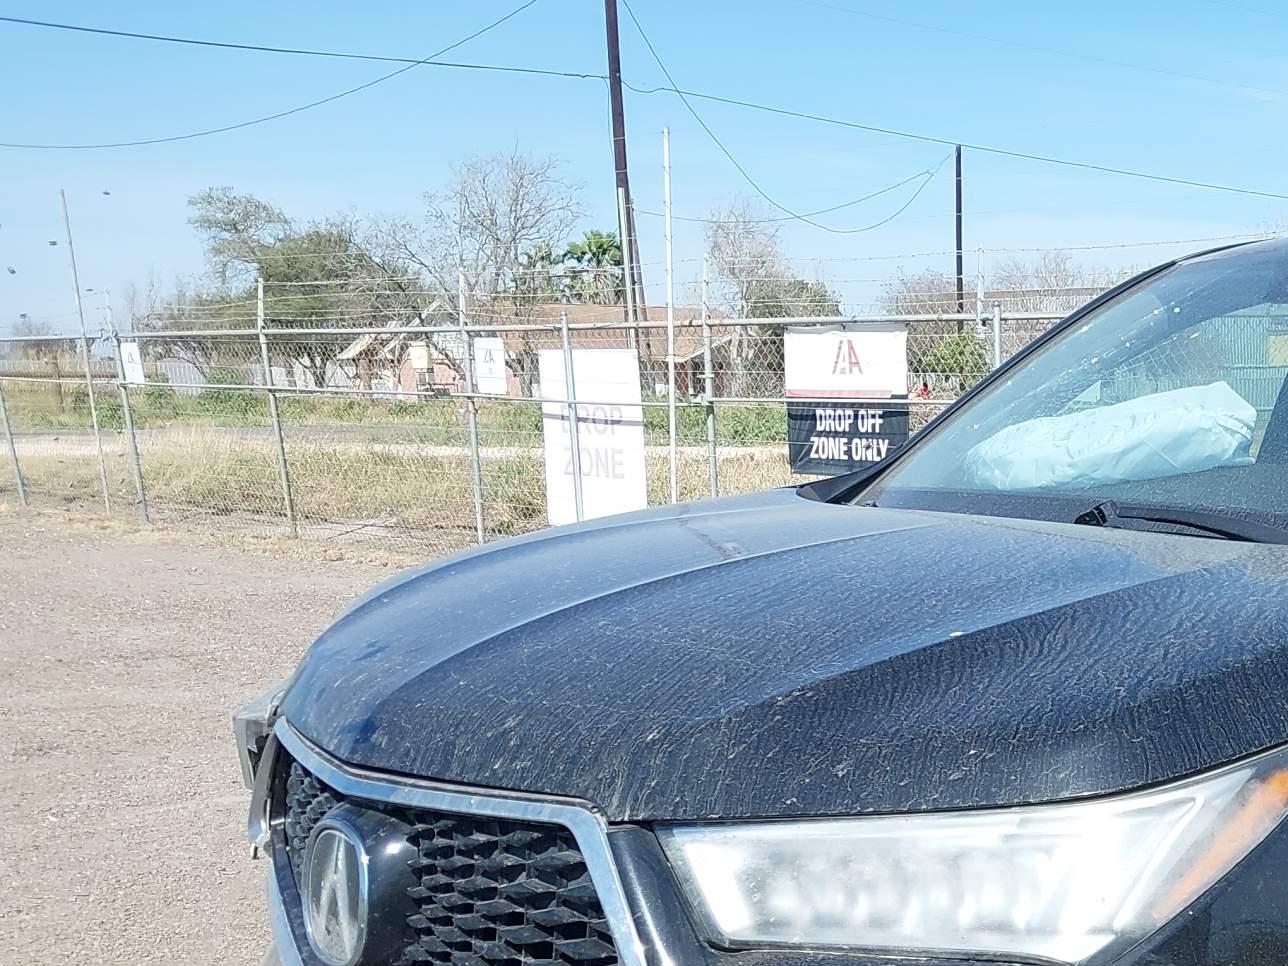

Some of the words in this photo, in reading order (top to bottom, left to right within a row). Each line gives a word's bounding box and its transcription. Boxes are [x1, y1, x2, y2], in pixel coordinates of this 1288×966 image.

[815, 409, 854, 432] DROP
[857, 410, 884, 433] OFF
[809, 436, 849, 460] ZONE
[851, 437, 889, 462] ONLY
